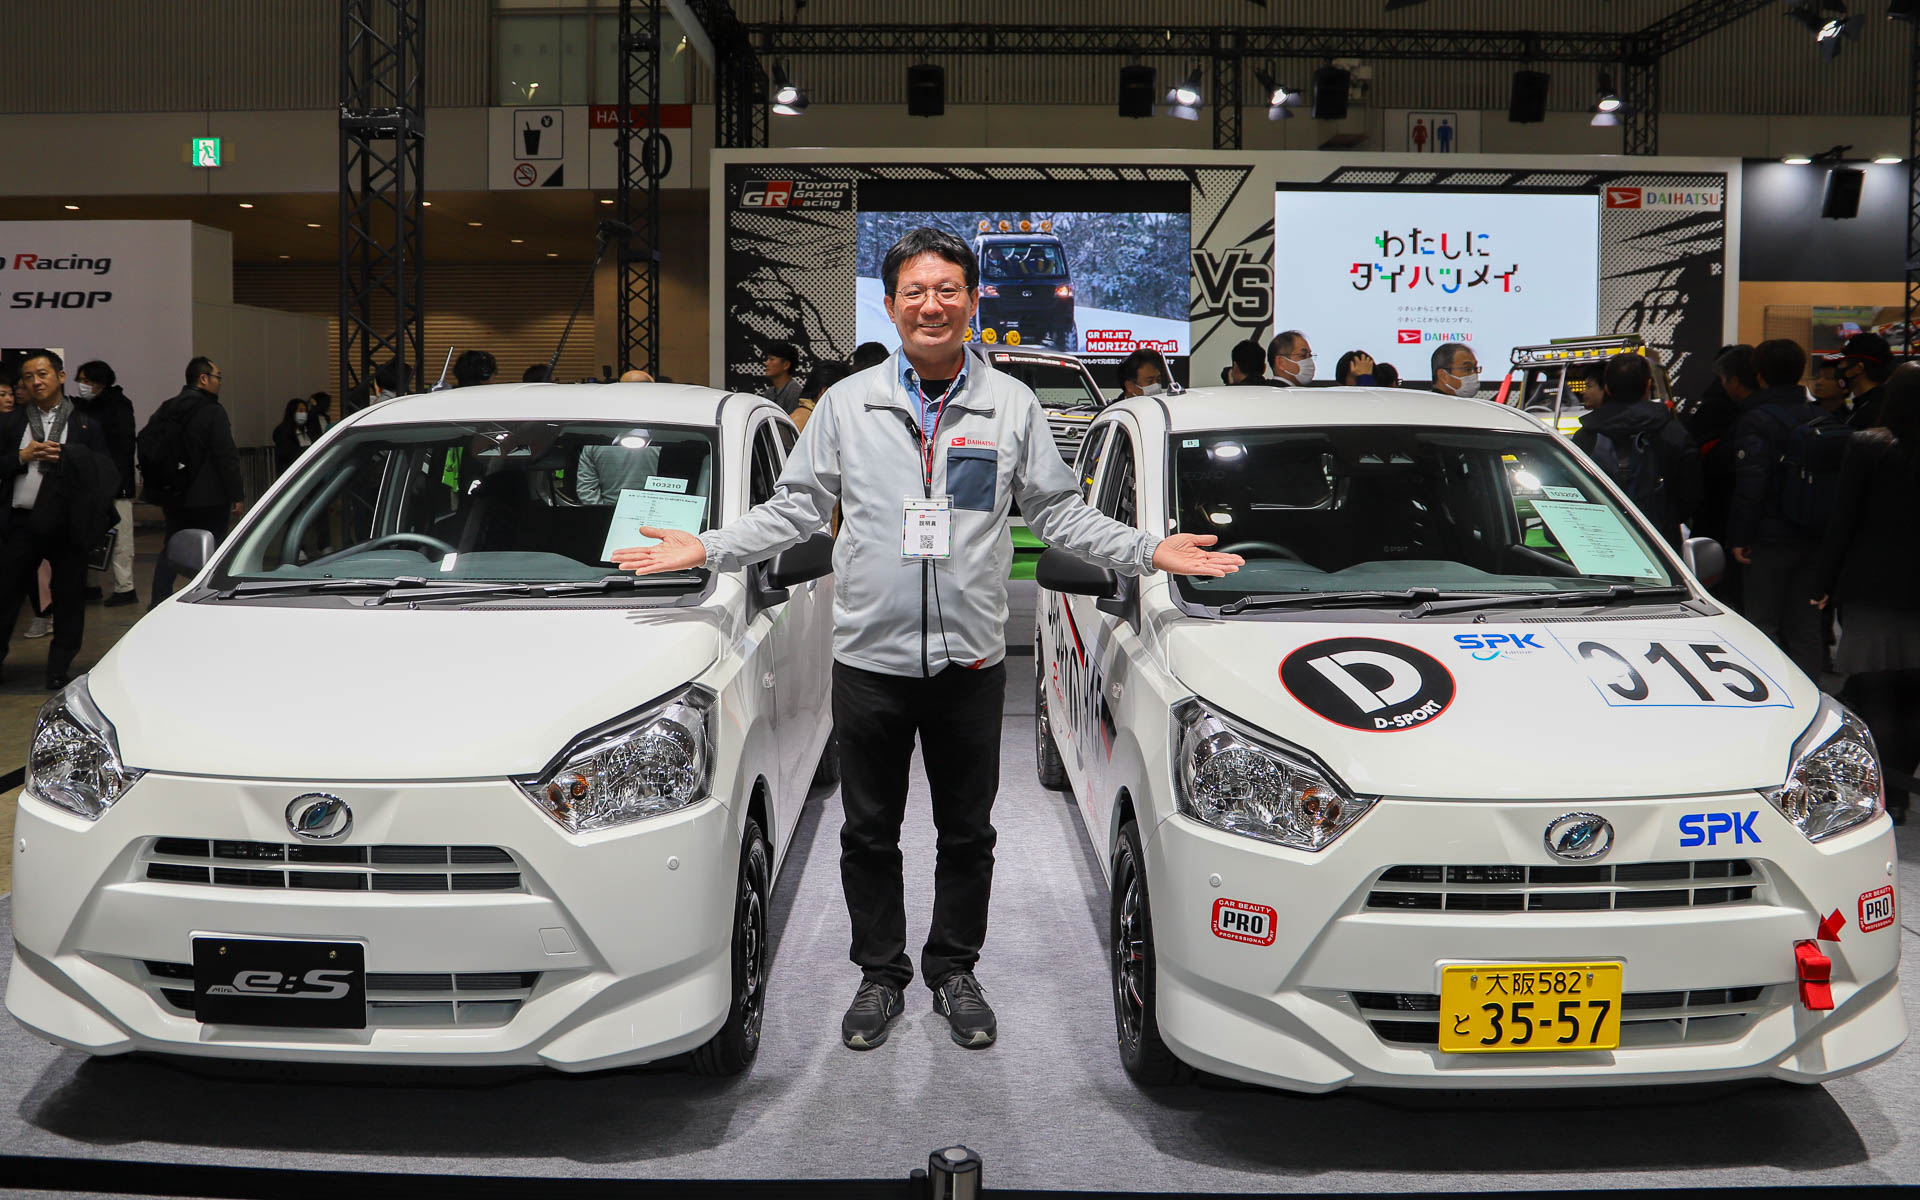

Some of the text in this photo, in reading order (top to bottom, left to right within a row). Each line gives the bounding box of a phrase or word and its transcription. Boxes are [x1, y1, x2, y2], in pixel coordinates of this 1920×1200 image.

[795, 181, 849, 190] TOYOTA
[742, 192, 788, 206] GR
[793, 190, 843, 198] GAZOO
[1646, 192, 1719, 205] DAIHATSU
[1375, 228, 1490, 260] わたしに
[13, 253, 112, 275] Racing
[10, 291, 113, 309] SHOP
[1424, 333, 1473, 342] DAIHATSU
[1088, 341, 1177, 352] MORIZO K-Trail
[1453, 633, 1545, 649] SPK
[1373, 699, 1442, 729] D-SPORT
[1679, 811, 1762, 847] SPK
[1218, 899, 1272, 914] CAR BEAUTY
[1866, 897, 1889, 921] PRO
[1223, 910, 1264, 934] PRO
[1219, 931, 1266, 945] PROFESSIONAL
[1453, 1000, 1611, 1046] と 35-57
